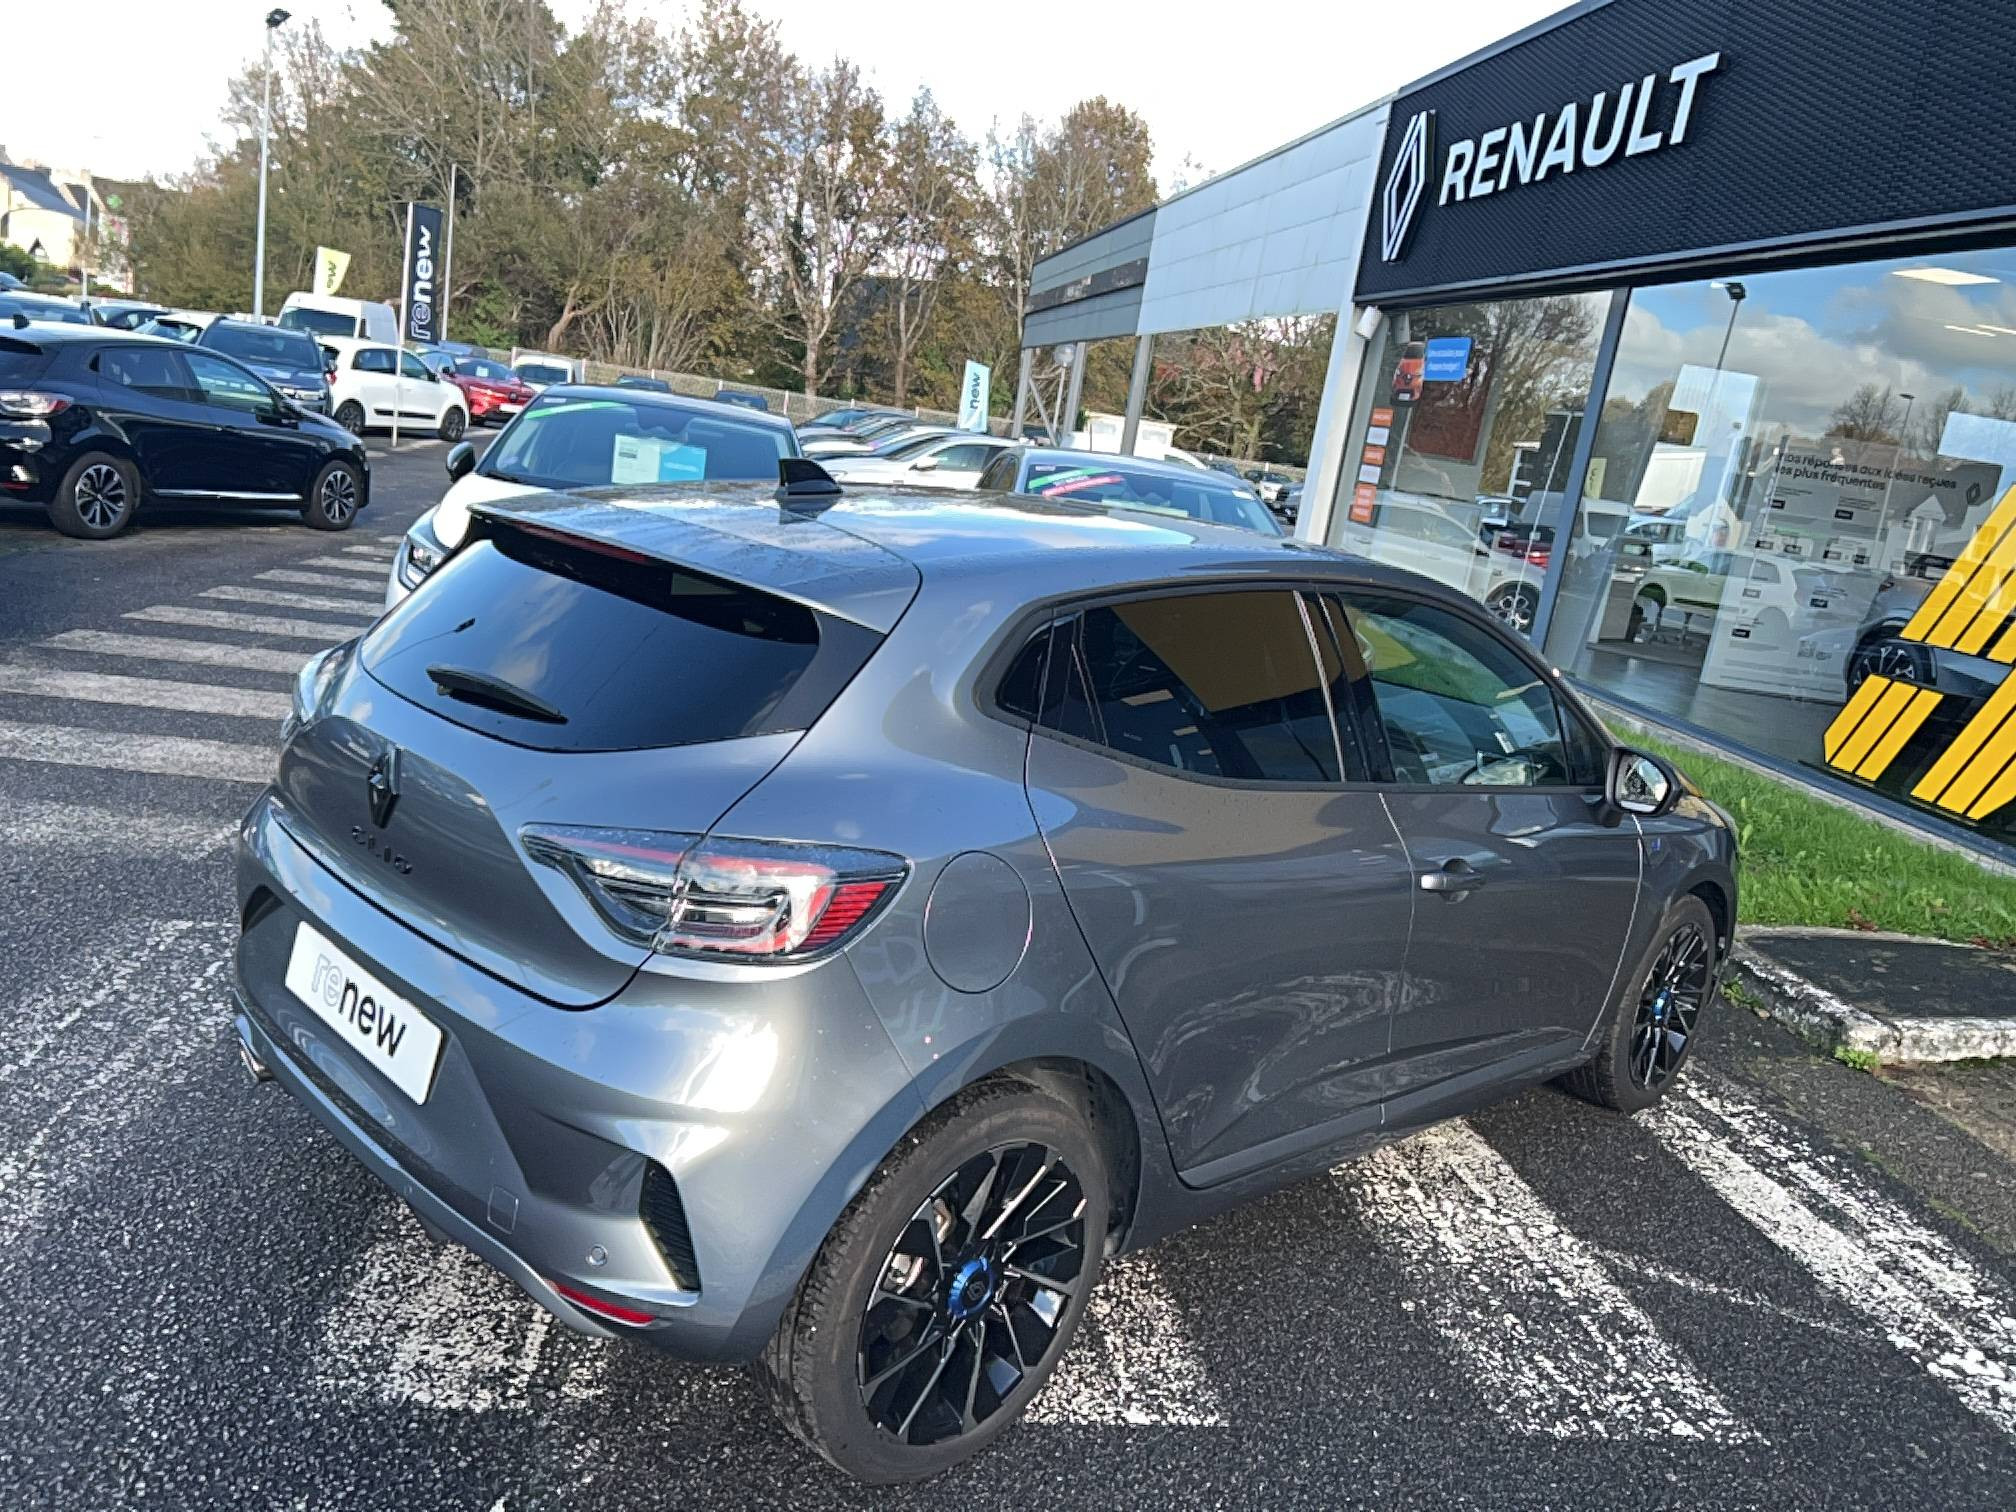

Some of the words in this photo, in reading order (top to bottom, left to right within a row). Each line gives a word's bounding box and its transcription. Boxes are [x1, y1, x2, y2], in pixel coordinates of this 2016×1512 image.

[1439, 52, 1719, 207] RENAULT
[411, 225, 433, 340] renew
[1793, 466, 1819, 479] plus
[1820, 470, 1886, 490] fréquentes
[1859, 465, 1882, 477] aux
[1918, 475, 1957, 489] reçues
[350, 825, 414, 875] CLIO
[311, 951, 408, 1058] renew
